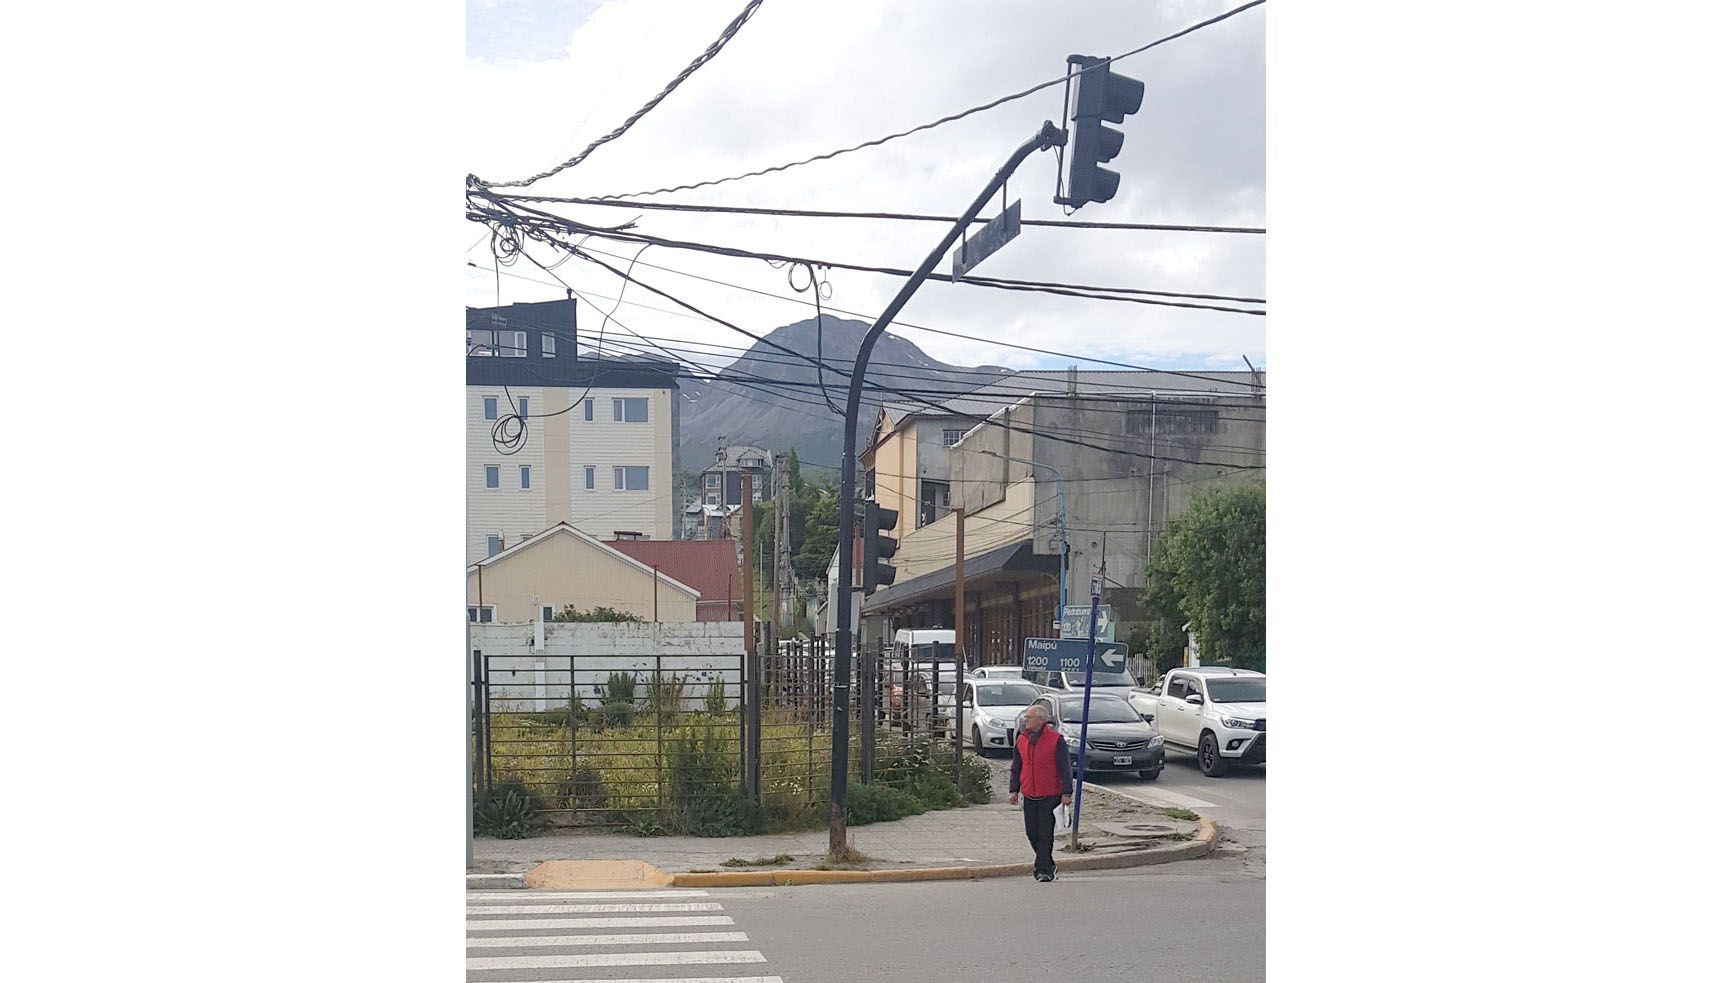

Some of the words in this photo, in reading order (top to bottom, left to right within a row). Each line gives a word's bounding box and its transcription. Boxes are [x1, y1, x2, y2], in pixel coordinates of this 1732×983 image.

[1028, 640, 1057, 651] Maipú
[1027, 656, 1048, 666] 1200
[1060, 658, 1080, 667] 1100
